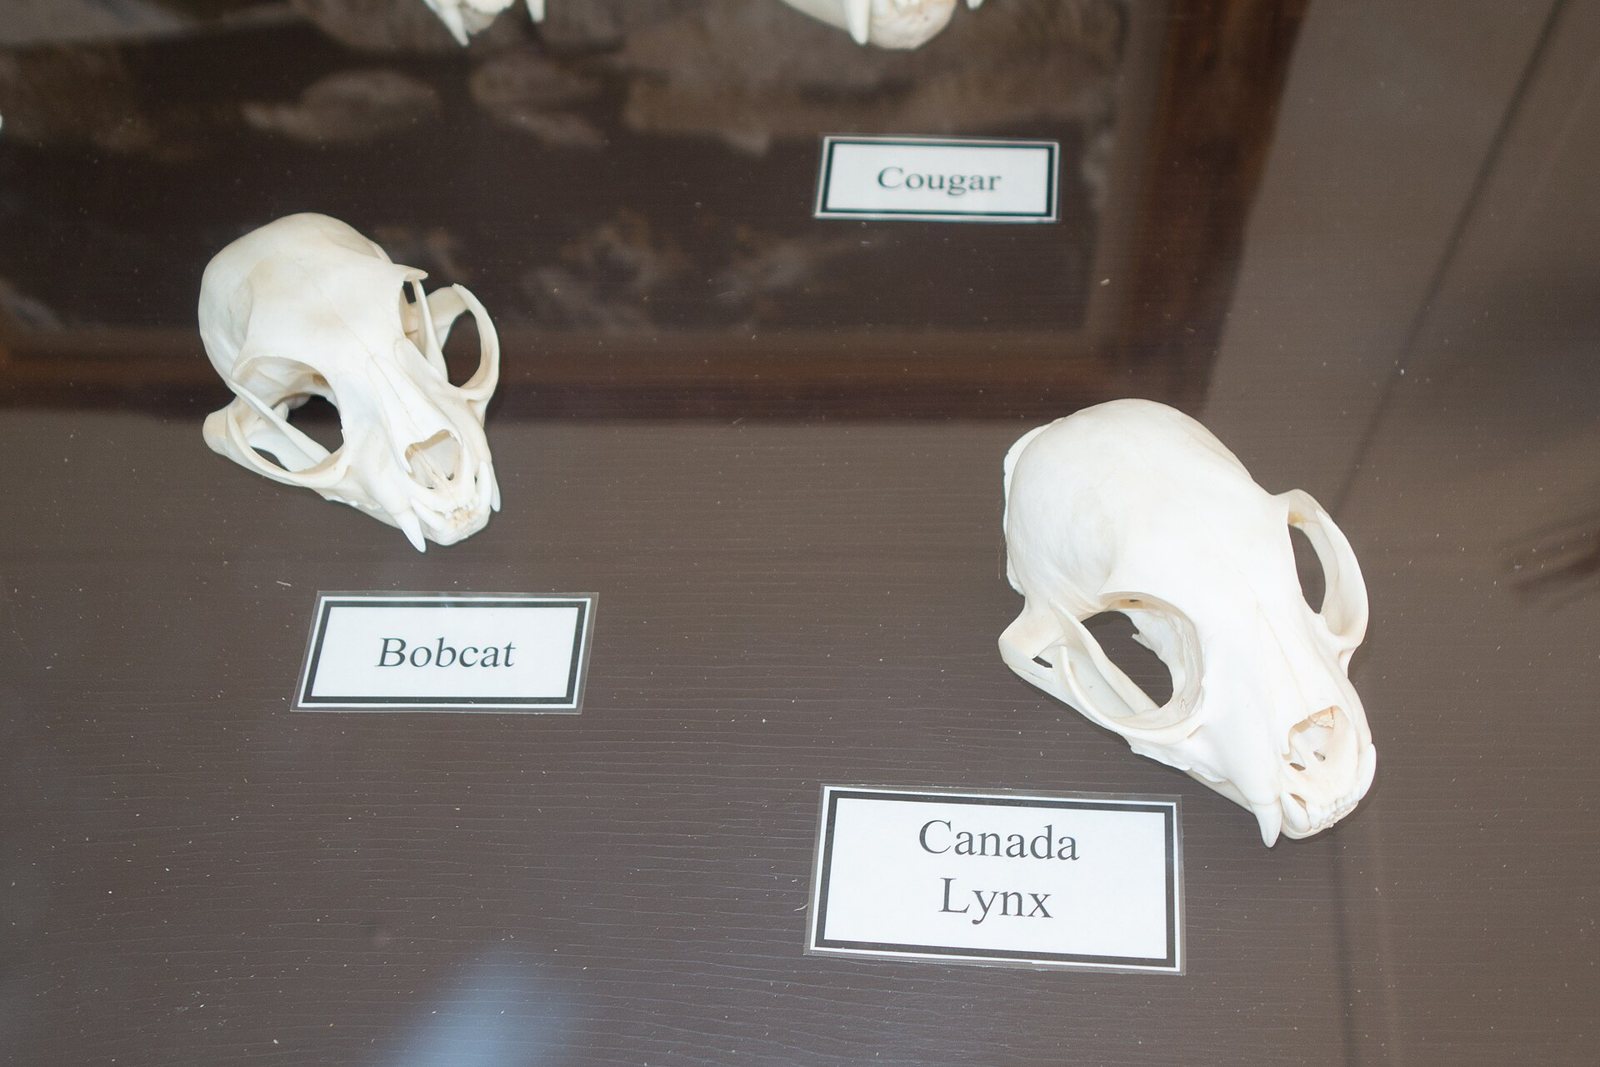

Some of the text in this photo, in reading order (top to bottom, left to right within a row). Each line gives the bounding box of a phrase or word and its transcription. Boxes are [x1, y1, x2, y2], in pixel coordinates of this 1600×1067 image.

[877, 166, 1002, 196] Cougar
[376, 636, 516, 668] Bobcat
[919, 819, 1079, 861] Canada
[939, 877, 1052, 925] Lynx
